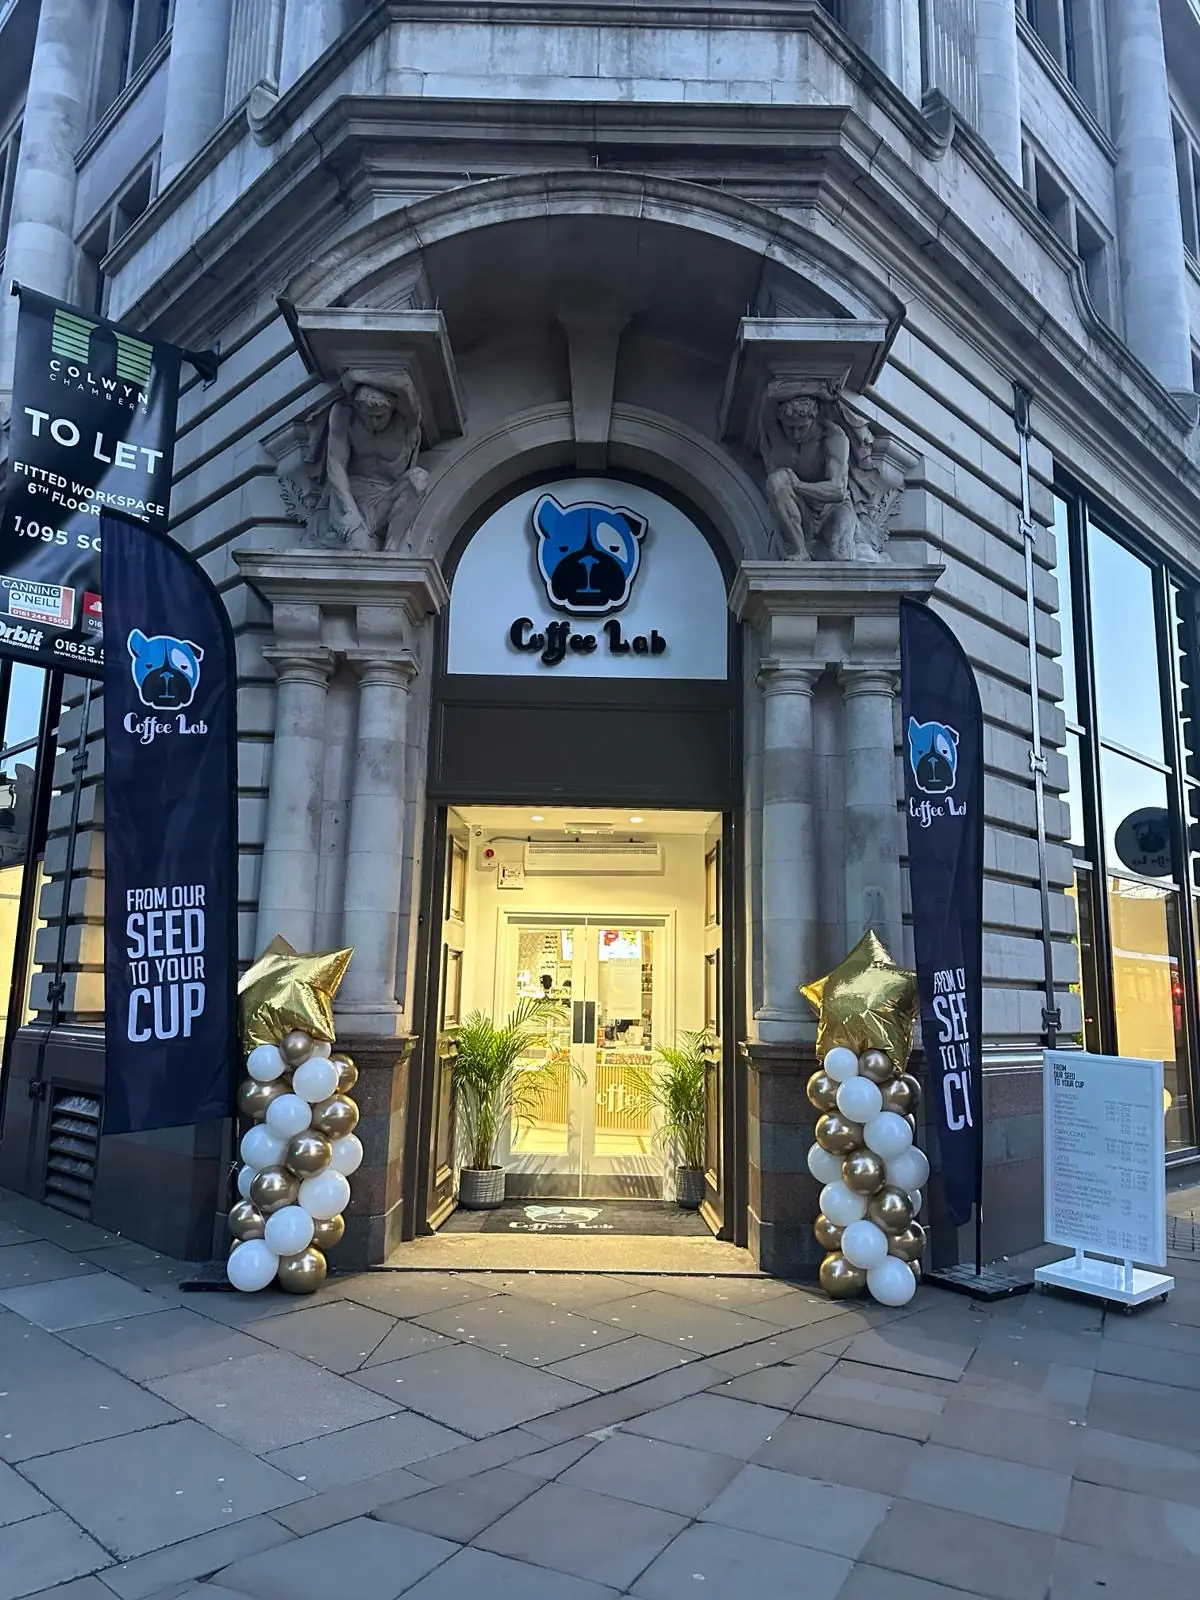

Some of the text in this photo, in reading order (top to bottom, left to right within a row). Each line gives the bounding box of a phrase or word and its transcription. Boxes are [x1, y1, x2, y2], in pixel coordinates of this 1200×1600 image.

[50, 360, 148, 404] COLWYN
[50, 374, 147, 414] CHAMBERS
[24, 407, 163, 474] TO LET
[14, 462, 165, 516] FITTED WORKSPACE
[28, 482, 100, 516] 6TH FLOOR
[14, 516, 68, 545] 1,095
[2, 580, 60, 596] CANNING
[12, 592, 60, 608] O'NEILL
[32, 613, 46, 621] 244
[48, 616, 69, 625] 5500
[54, 638, 96, 656] 01625
[510, 617, 667, 666] Coffee Lab
[124, 712, 172, 744] Coffee
[127, 885, 206, 912] FROM OUR
[126, 908, 206, 958] SEED
[129, 956, 205, 986] TO YOUR
[933, 969, 956, 994] FROM
[128, 982, 206, 1042] CUP
[939, 1045, 958, 1071] TO
[1054, 1071, 1076, 1080] OUR SEED
[1054, 1078, 1085, 1088] TO YOUR CUP
